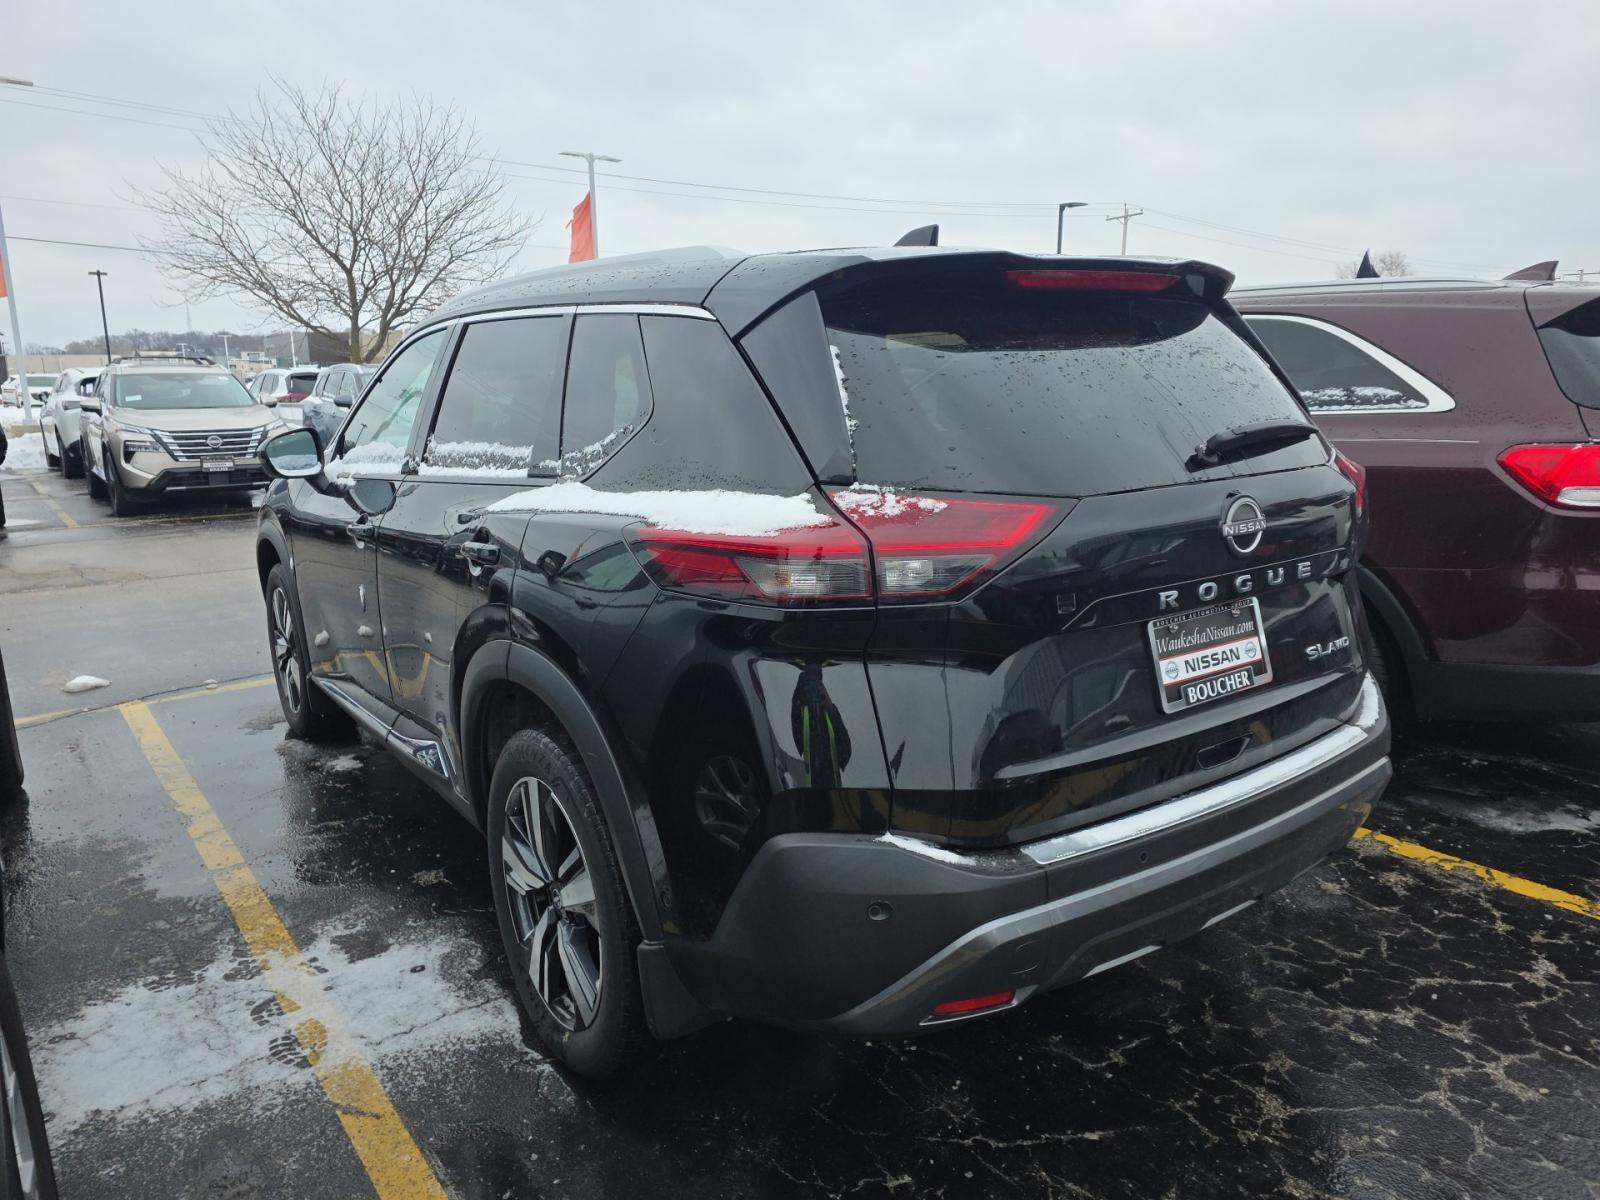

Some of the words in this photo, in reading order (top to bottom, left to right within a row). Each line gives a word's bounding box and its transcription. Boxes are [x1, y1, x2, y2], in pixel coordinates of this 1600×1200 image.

[1225, 520, 1267, 536] NISSAN
[1158, 561, 1312, 611] ROGUE
[1156, 621, 1255, 654] WaukeshaNissan.com
[1184, 647, 1241, 674] NISSAN
[1187, 671, 1251, 704] BOUCHER
